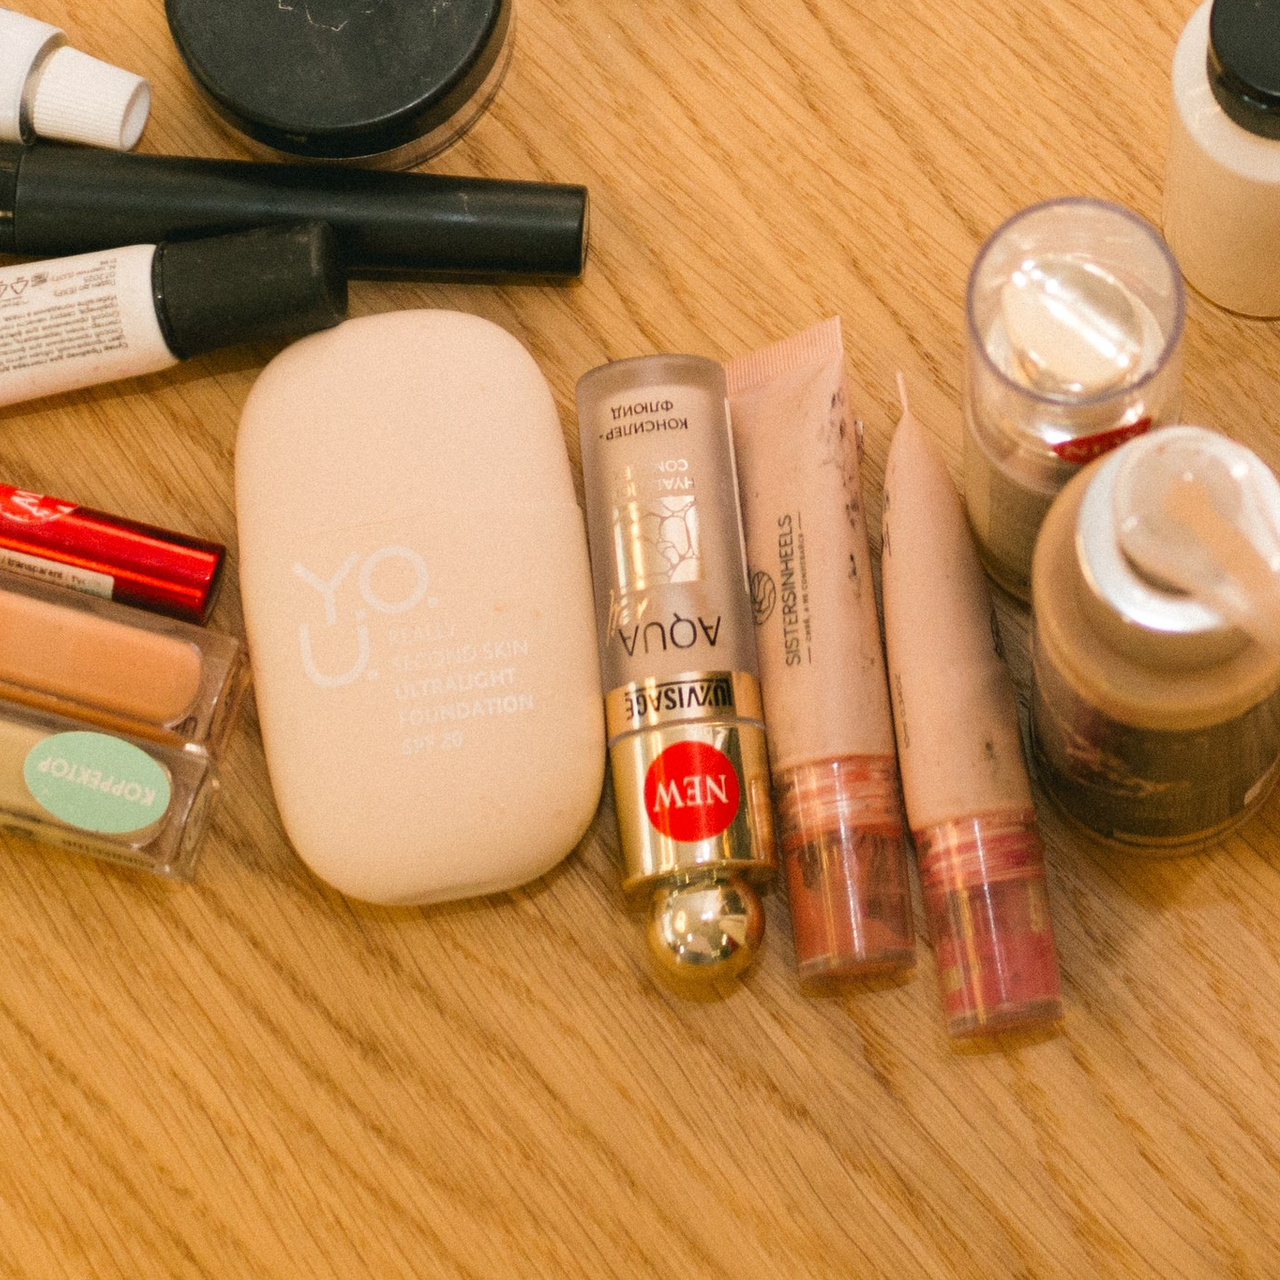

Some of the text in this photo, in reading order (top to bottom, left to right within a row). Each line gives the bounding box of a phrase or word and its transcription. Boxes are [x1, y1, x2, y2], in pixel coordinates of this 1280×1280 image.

[610, 399, 674, 420] ФЛЮИД
[778, 513, 801, 667] SISTERSINHEELS
[618, 612, 722, 657] AQUA
[37, 756, 157, 807] КОРРЕКТОР
[653, 774, 730, 813] NEW
